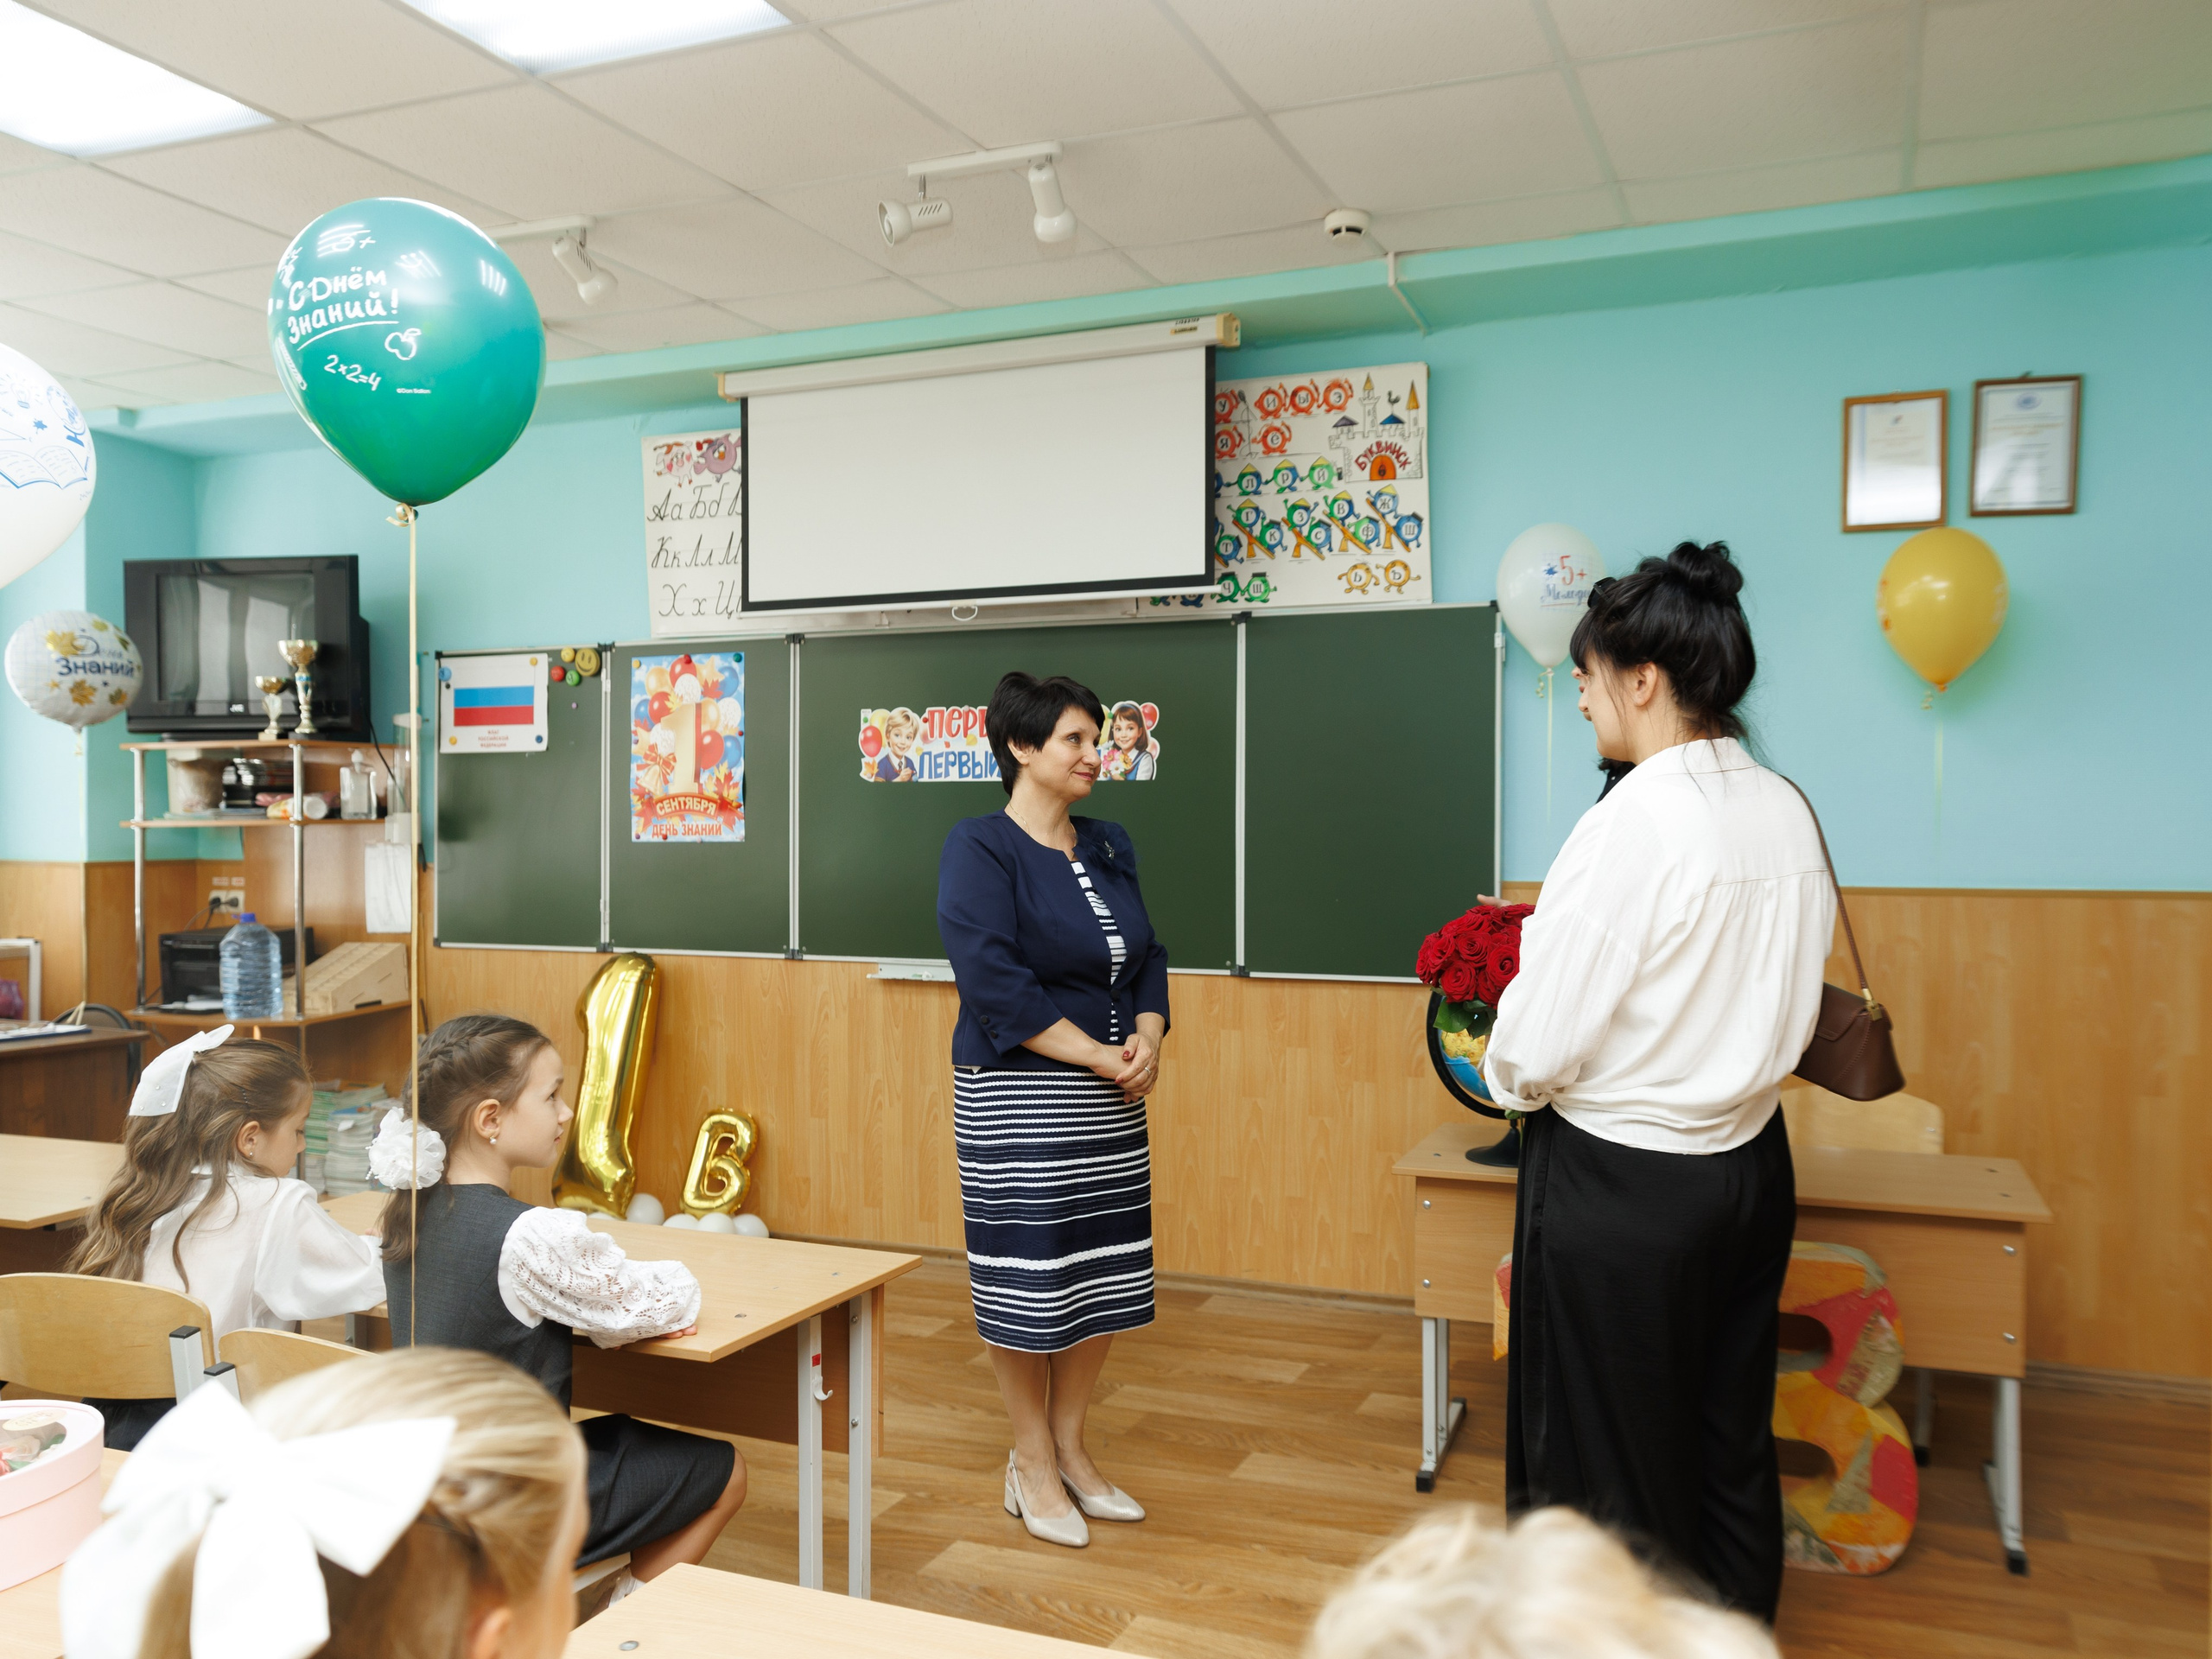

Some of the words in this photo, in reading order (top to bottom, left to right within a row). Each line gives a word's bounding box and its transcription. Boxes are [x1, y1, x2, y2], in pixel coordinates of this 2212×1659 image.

[289, 280, 306, 311] С
[308, 266, 386, 302] Днём
[1354, 441, 1412, 471] БУКВИНСК
[1560, 555, 1587, 586] 5+
[715, 579, 741, 620] Ц
[55, 657, 135, 677] Знаний
[656, 797, 716, 816] СЕНТЯБРЯ
[652, 823, 678, 838] ДЕНЬ
